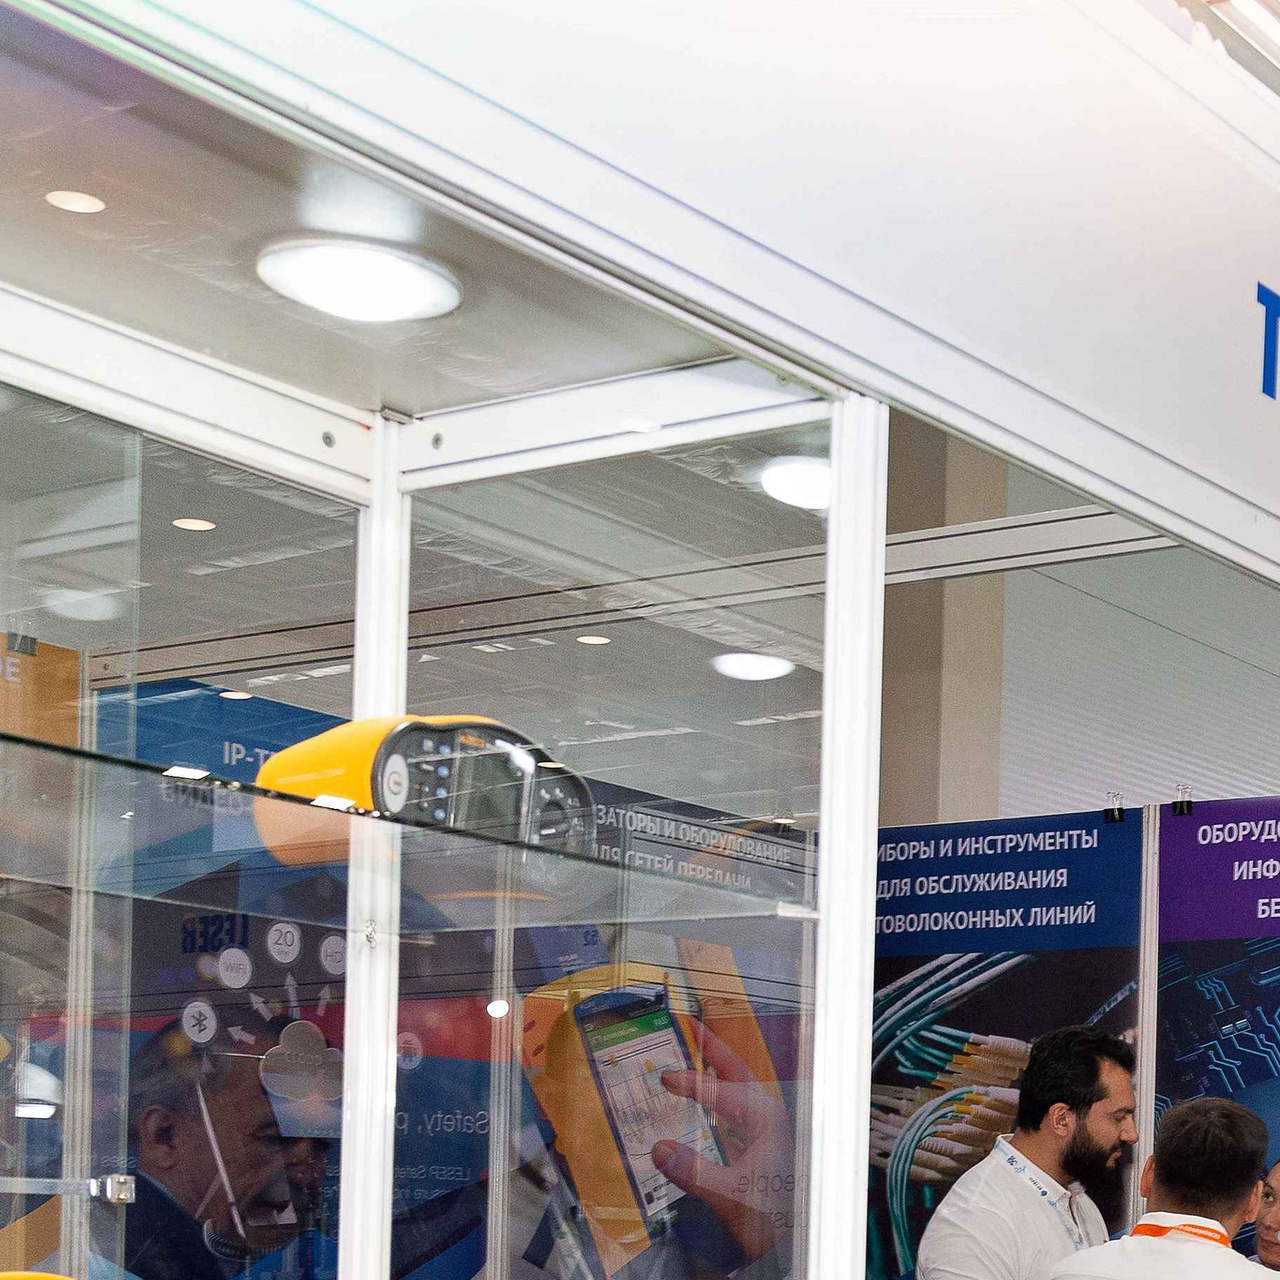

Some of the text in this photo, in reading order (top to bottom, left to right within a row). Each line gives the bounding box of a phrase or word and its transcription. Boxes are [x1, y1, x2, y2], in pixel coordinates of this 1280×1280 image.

[596, 804, 660, 835] ЗАТОРЫ
[876, 829, 1098, 863] ИБОРЫ И ИНСТРУМЕНТЫ
[876, 868, 1068, 900] ДЛЯ ОБСЛУЖИВАНИЯ
[875, 901, 1096, 934] ТОВОЛОКОННЫХ ЛИНИЙ
[273, 929, 296, 948] 20
